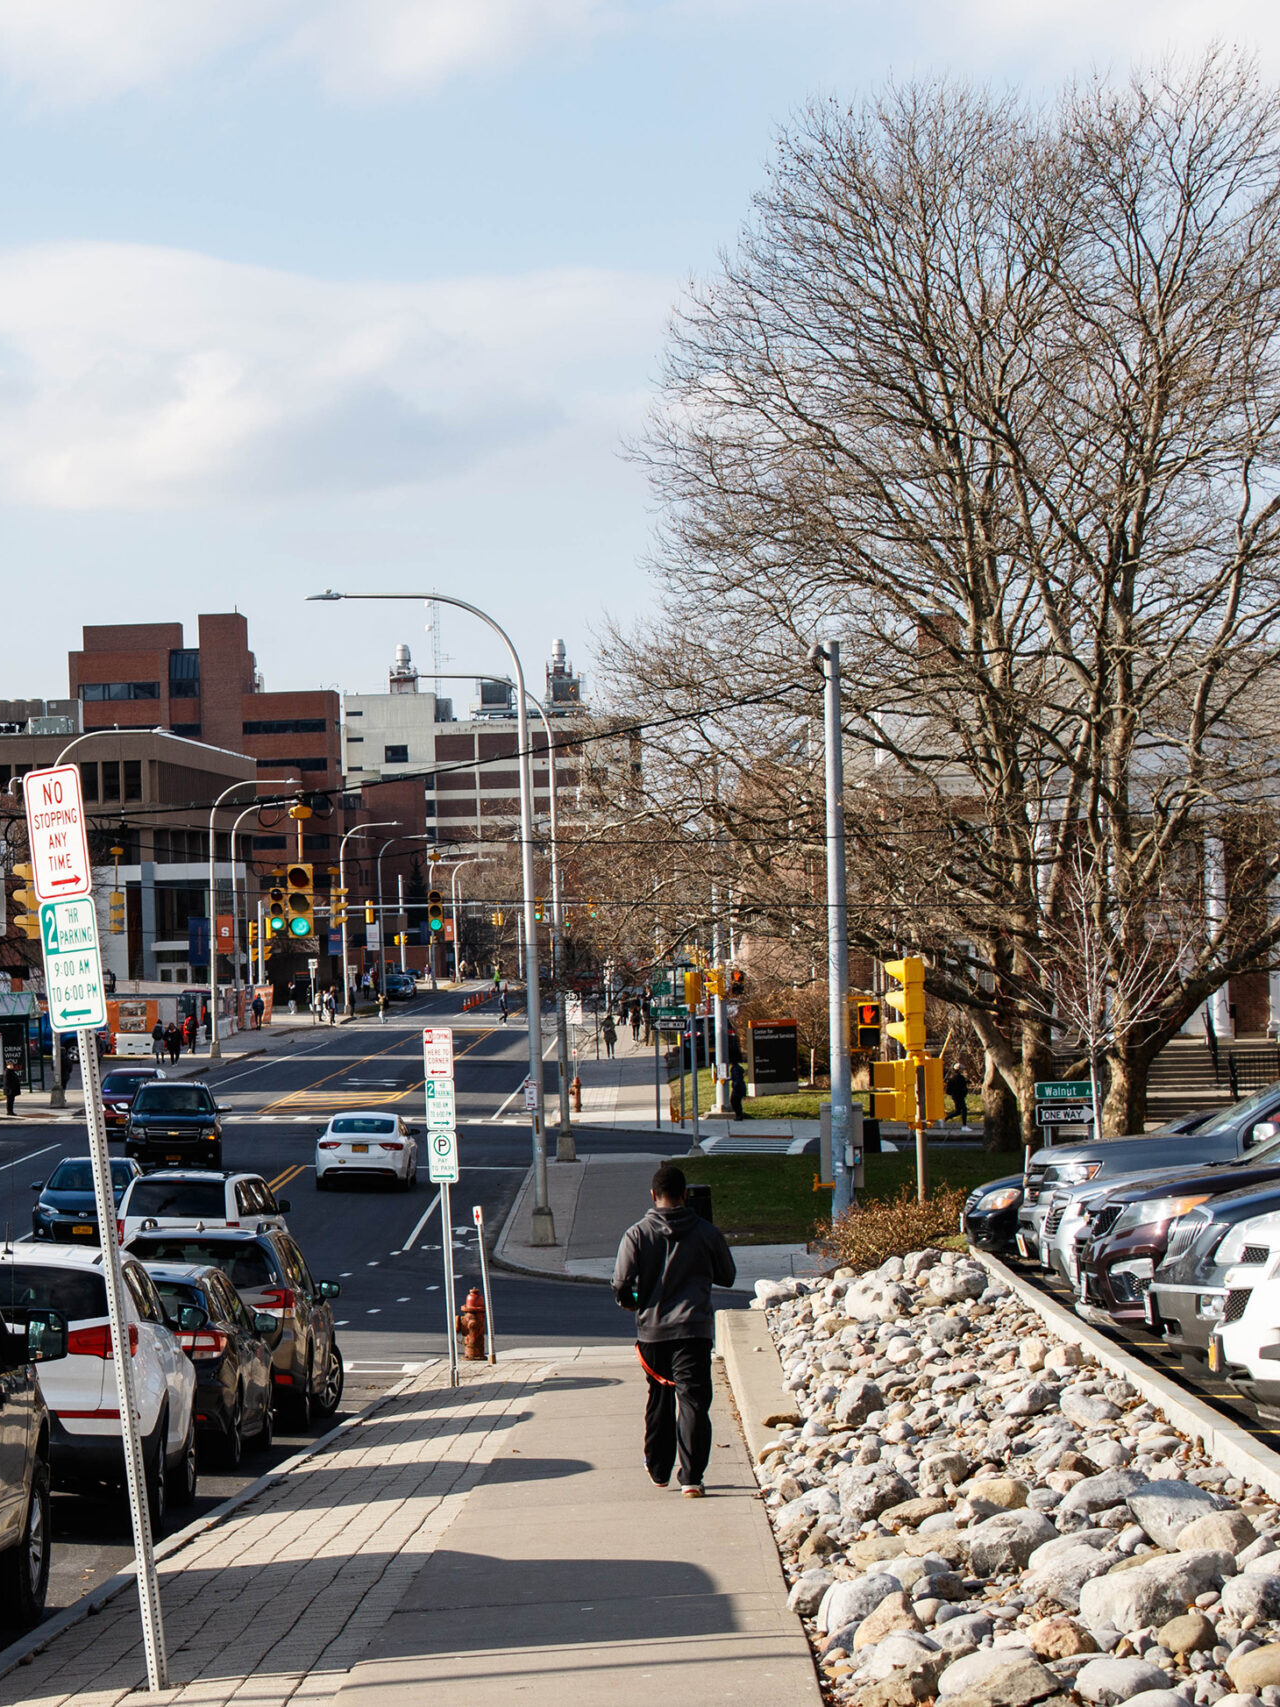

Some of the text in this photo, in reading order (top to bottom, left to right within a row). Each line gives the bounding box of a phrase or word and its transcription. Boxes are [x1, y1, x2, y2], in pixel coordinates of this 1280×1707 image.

[42, 781, 63, 805] NO
[33, 807, 78, 830] STOPPING
[48, 832, 67, 849] ANY
[48, 853, 73, 872] TIME
[68, 907, 79, 923] HR
[45, 910, 59, 949] 2
[59, 926, 93, 945] PARKING
[221, 926, 230, 937] S
[54, 959, 91, 977] 9:00 AM
[52, 983, 98, 1003] TO 6:00 PM
[427, 1083, 434, 1096] 2
[1044, 1086, 1076, 1097] Walnut
[1044, 1110, 1082, 1119] ONE WAY
[439, 1139, 447, 1152] P
